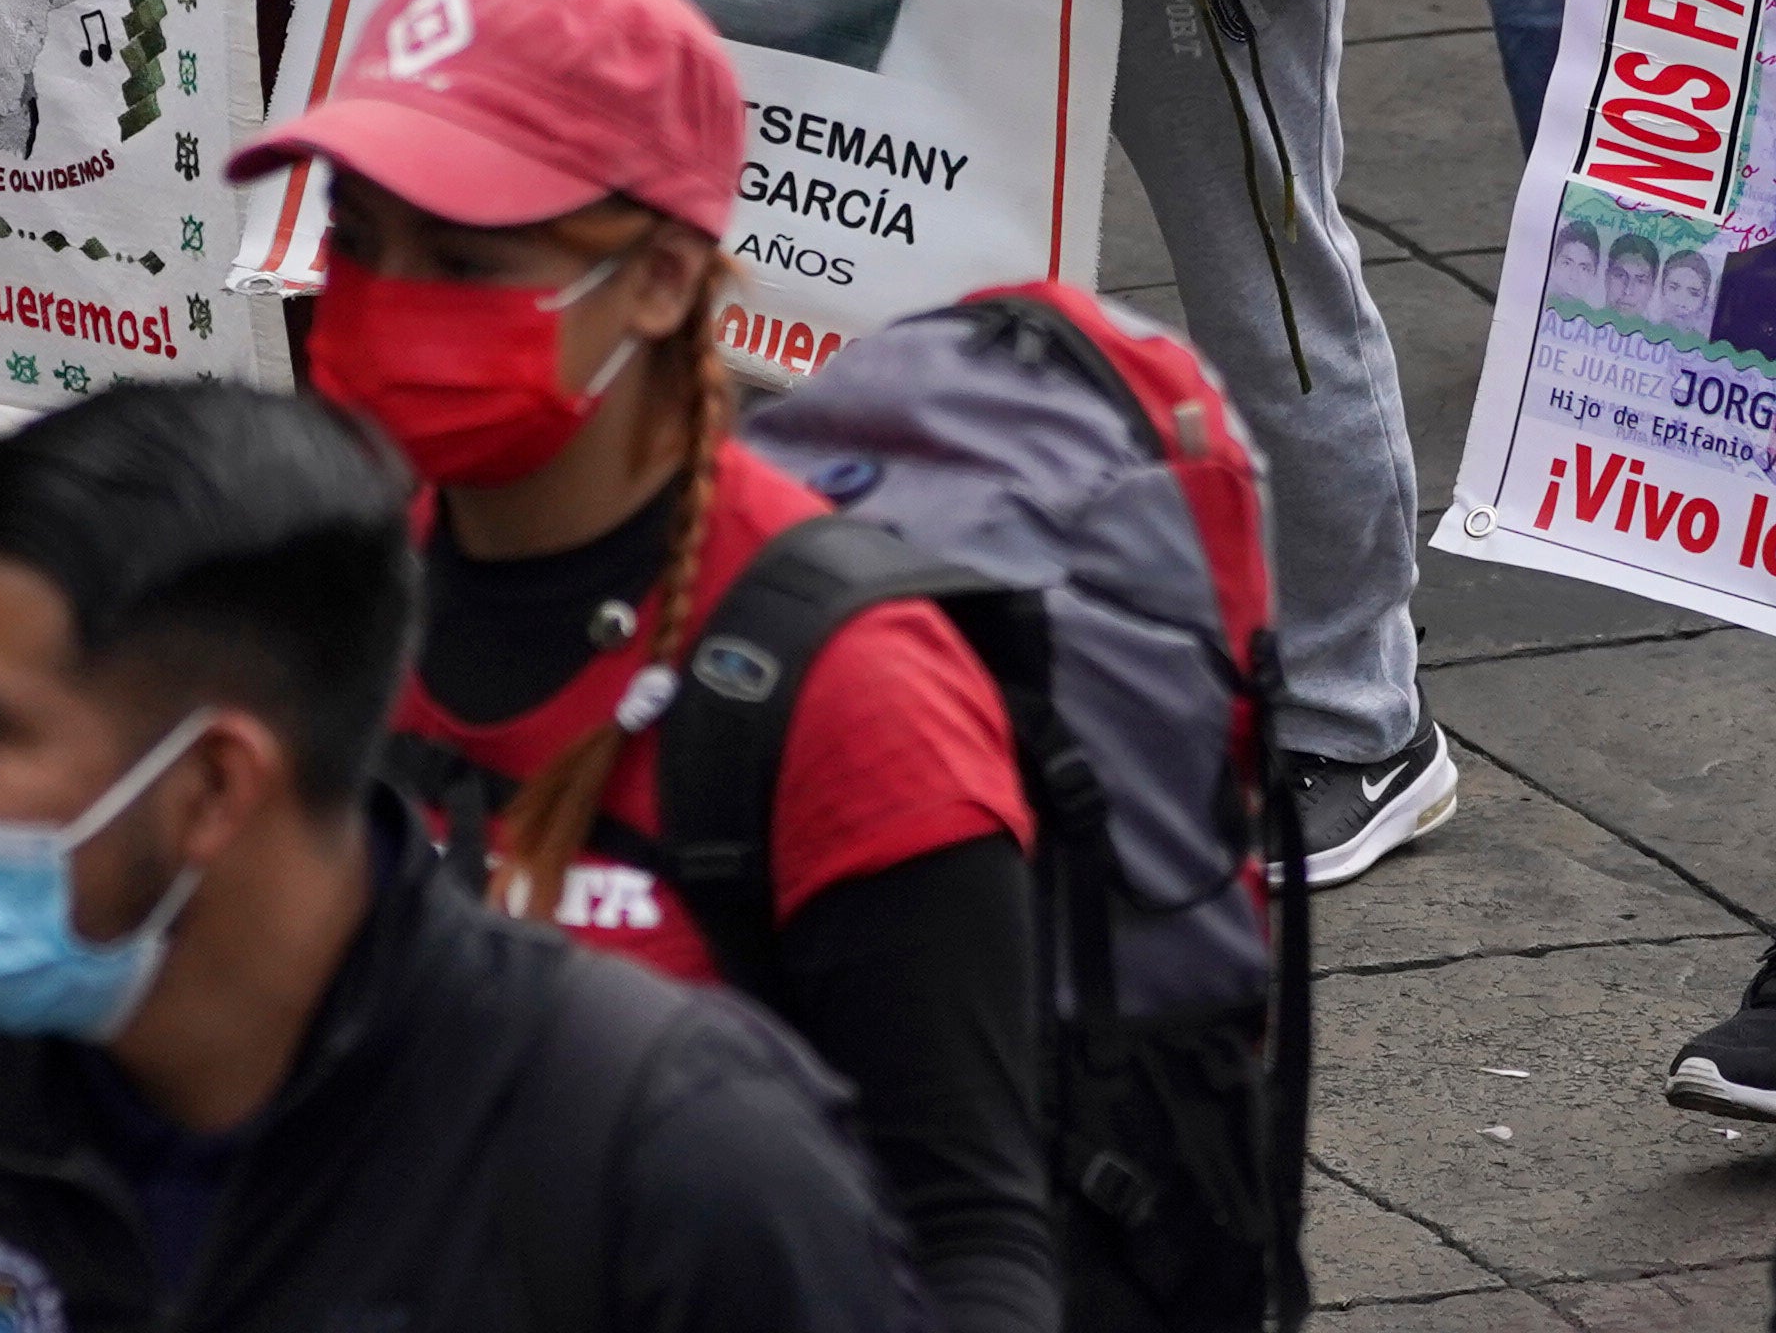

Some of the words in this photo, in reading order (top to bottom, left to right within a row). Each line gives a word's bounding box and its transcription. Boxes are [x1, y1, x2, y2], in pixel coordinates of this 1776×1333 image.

[1585, 51, 1733, 212] NOS
[8, 148, 116, 194] OLVIDEMOS
[735, 160, 915, 246] GARCÍA
[733, 233, 857, 287] AÑOS
[1536, 343, 1566, 375] DE
[1571, 350, 1666, 401] JUÁREZ
[1549, 386, 1602, 422] Hijo
[1612, 405, 1641, 429] de
[1651, 416, 1755, 463] Epifanio
[1533, 443, 1721, 555] ¡Vivo
